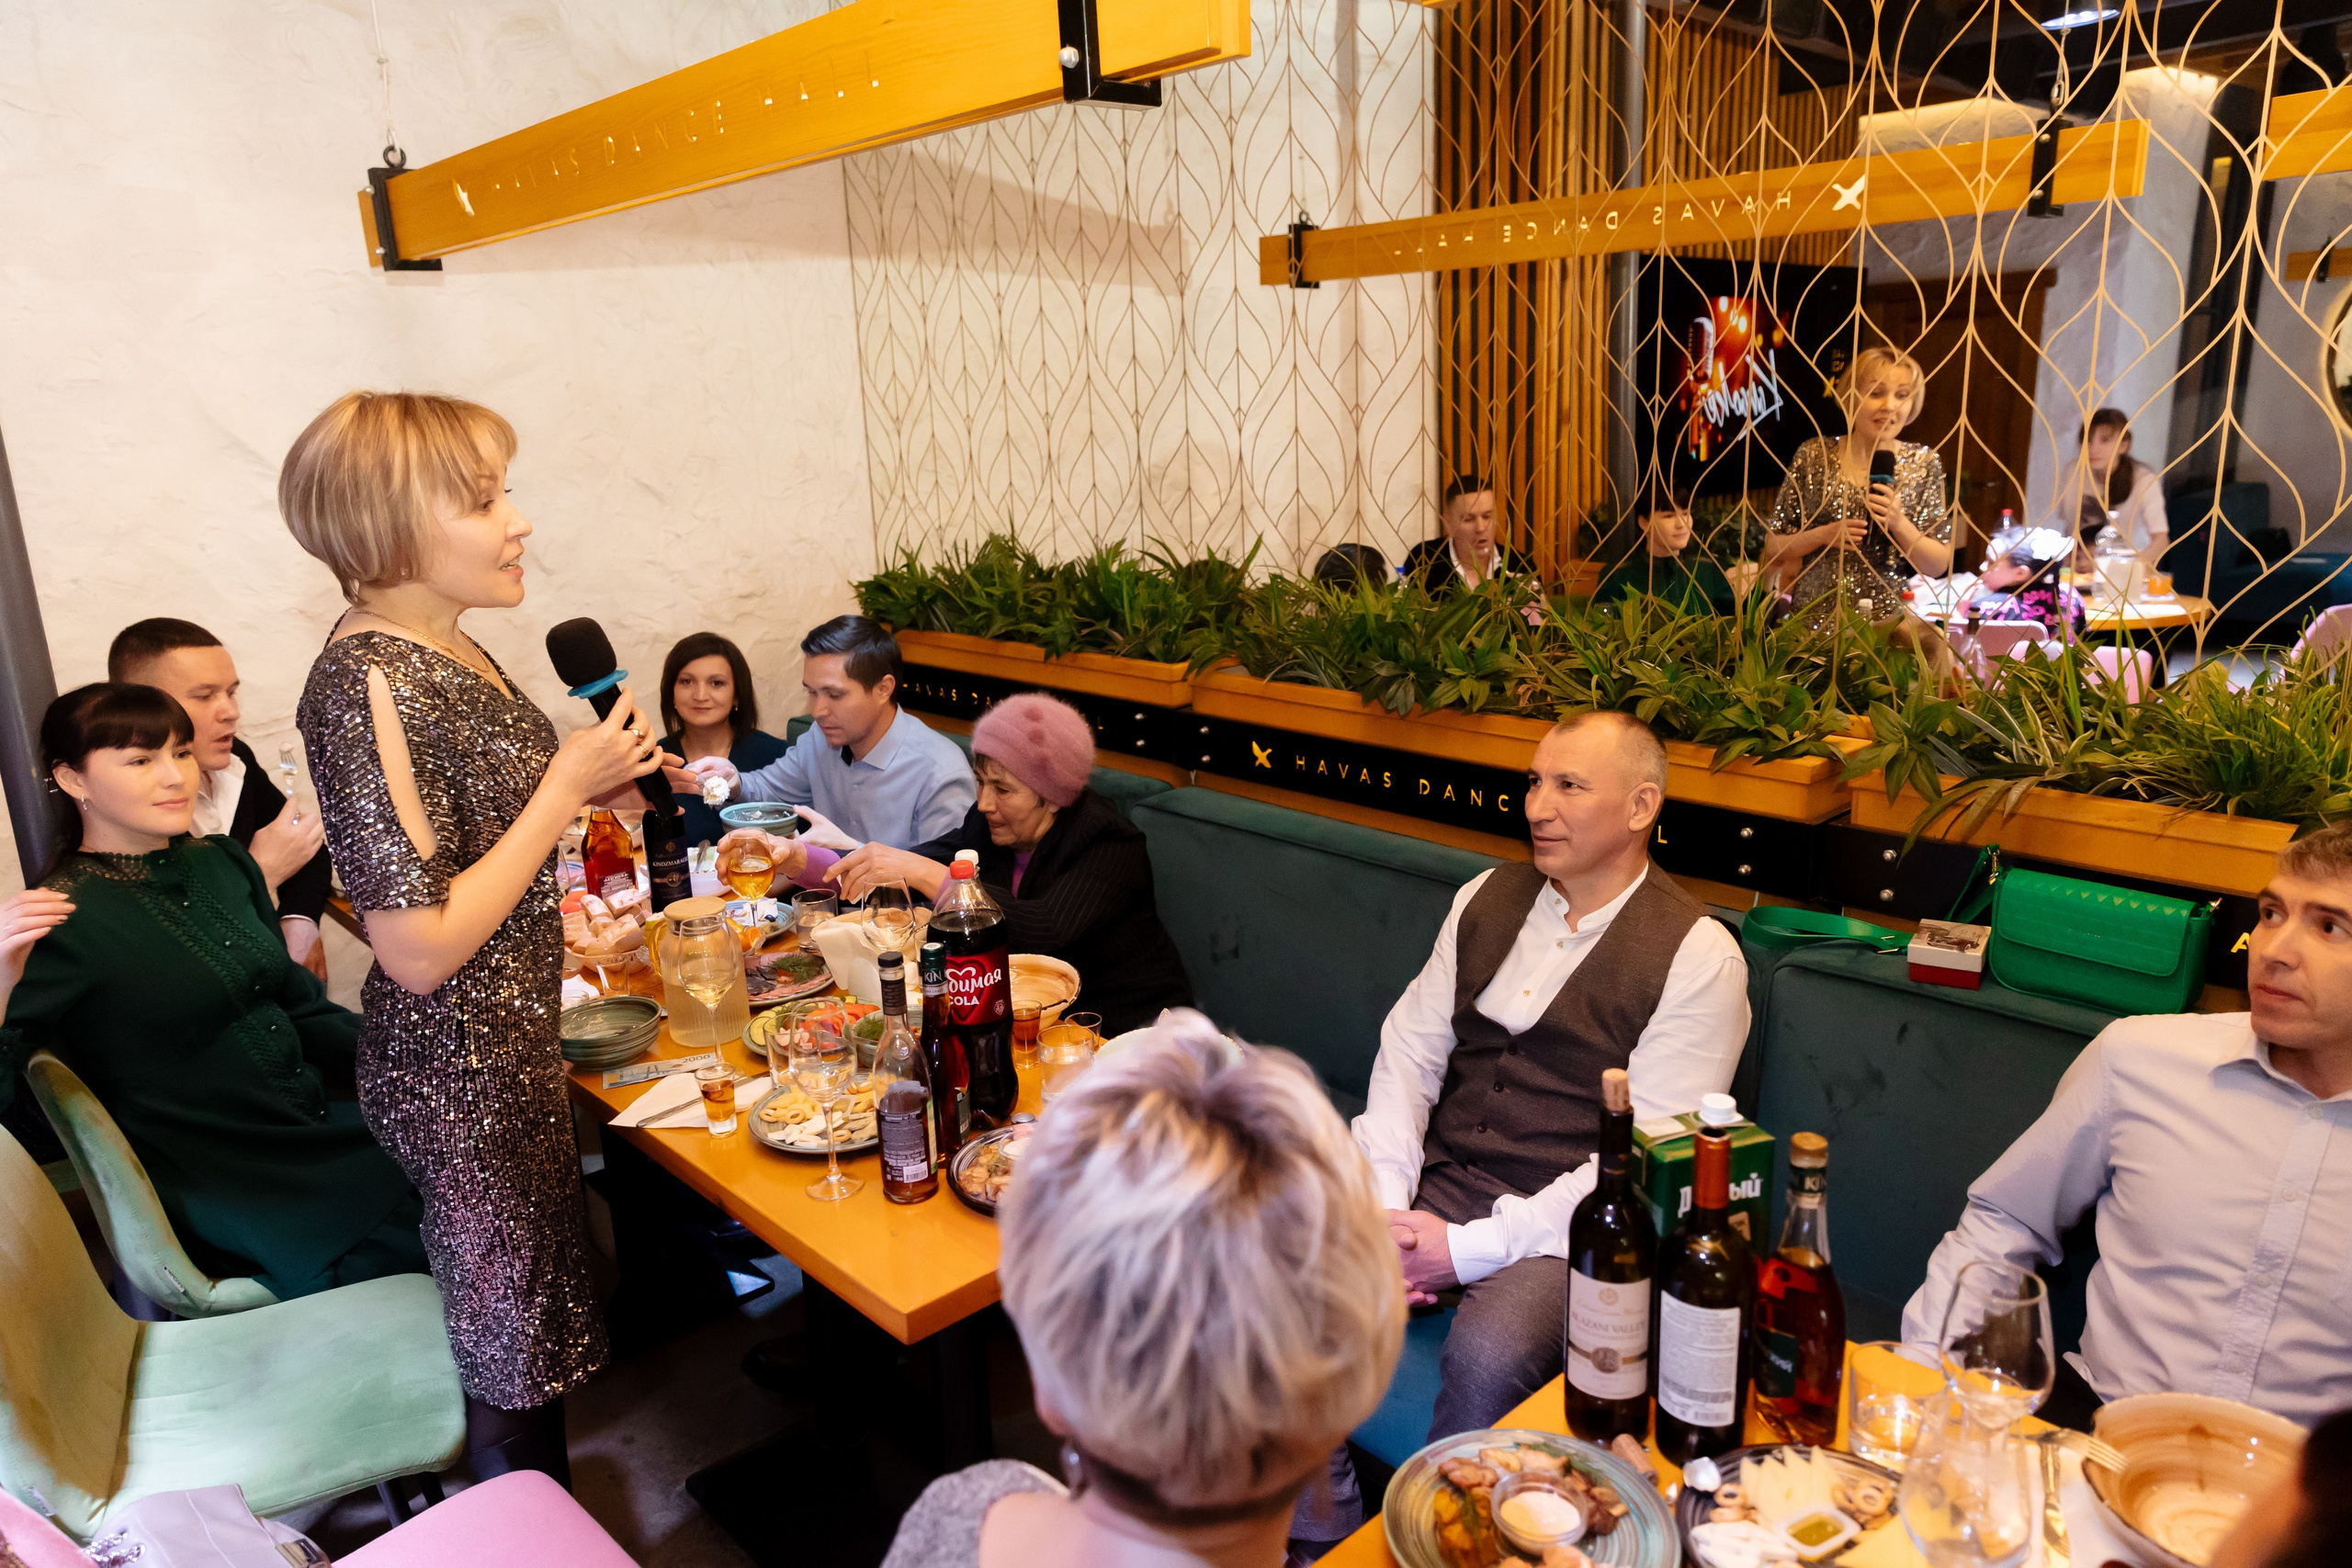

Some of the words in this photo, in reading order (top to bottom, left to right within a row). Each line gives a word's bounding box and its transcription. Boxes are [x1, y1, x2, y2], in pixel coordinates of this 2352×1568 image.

[603, 100, 725, 167] DANCE
[1295, 754, 1392, 788] HAVAS
[1419, 778, 1510, 812] DANC
[945, 966, 1002, 994] бимая
[948, 995, 980, 1007] COLA
[682, 1054, 711, 1064] 2000
[1677, 1172, 1764, 1219] Дый
